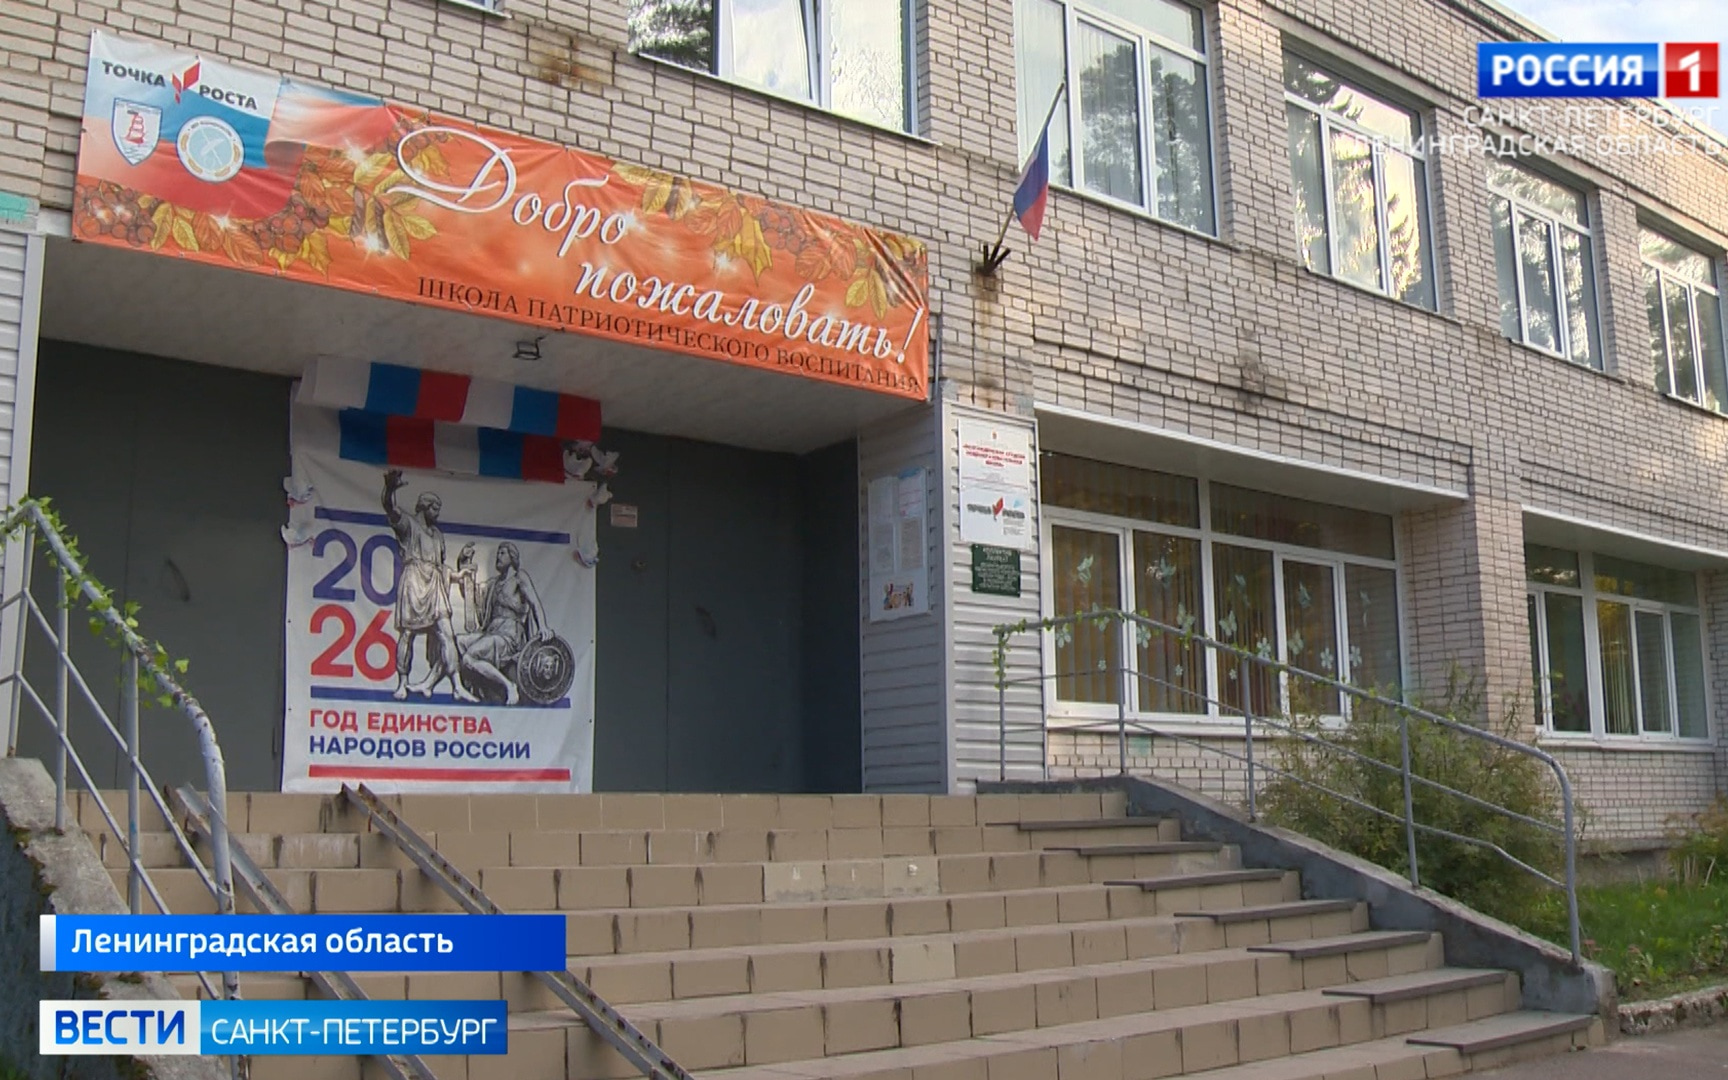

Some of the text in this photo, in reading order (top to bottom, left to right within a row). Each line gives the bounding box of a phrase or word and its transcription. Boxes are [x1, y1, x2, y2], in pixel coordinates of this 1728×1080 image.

[101, 59, 258, 111] ТОЧКА РОСТА
[386, 126, 629, 257] Добро
[417, 276, 921, 394] ШКОЛА ПАТРИОТИЧЕСКОГО ВОСПИТАНИЯ
[574, 260, 925, 364] пожаловать!
[312, 528, 398, 606] 20
[310, 603, 398, 681] 26
[310, 709, 493, 734] ГОД ЕДИНСТВА
[310, 735, 531, 759] НАРОДОВ РОССИИ
